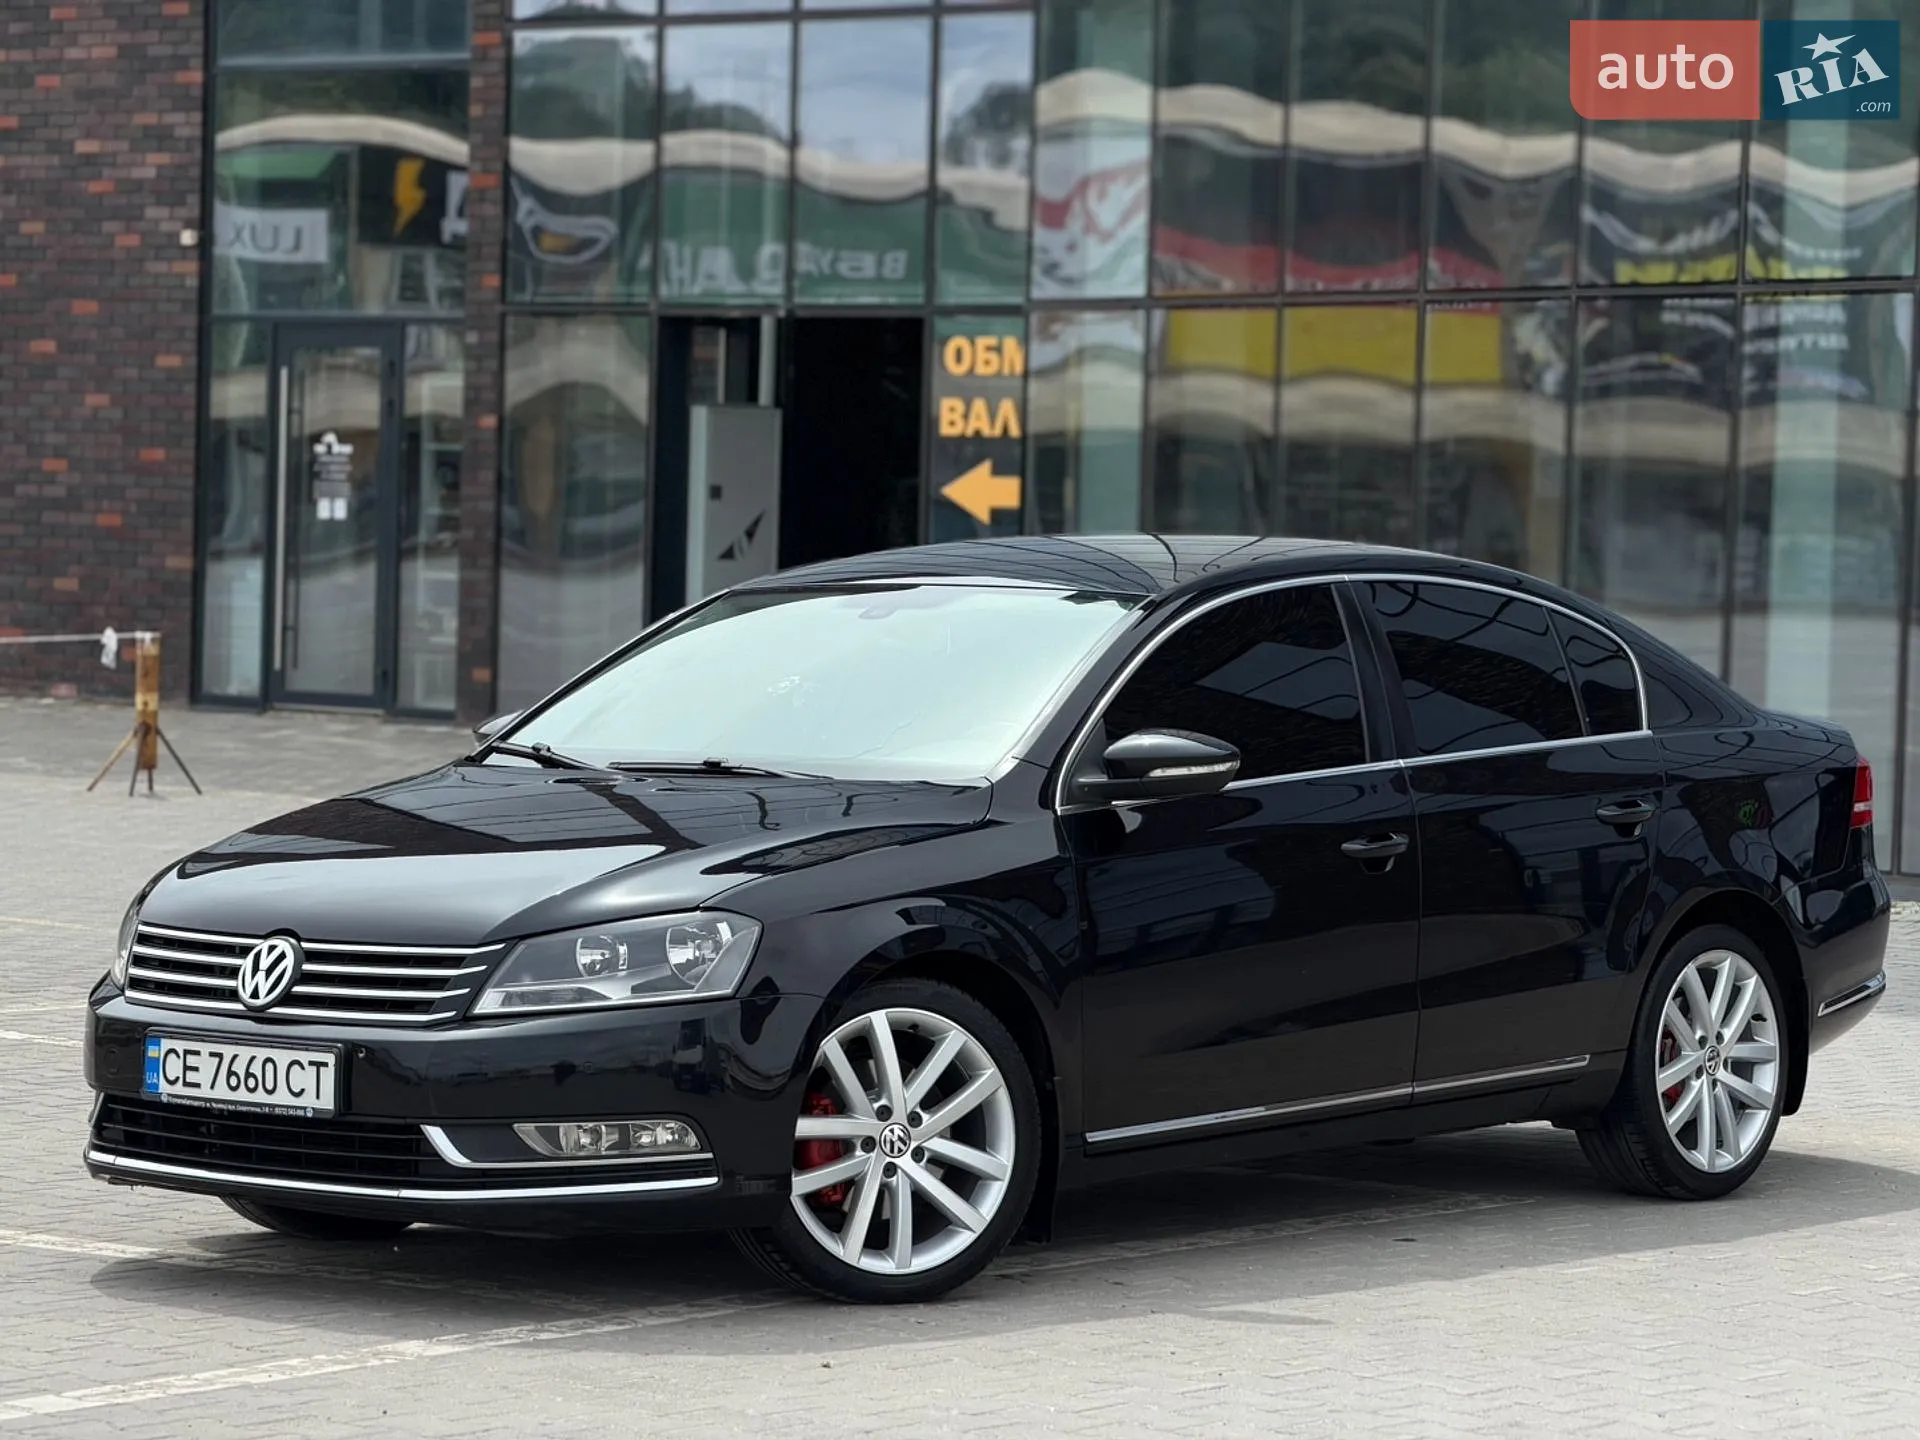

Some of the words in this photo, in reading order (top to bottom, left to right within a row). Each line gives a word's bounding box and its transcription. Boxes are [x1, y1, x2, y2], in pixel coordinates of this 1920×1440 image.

[939, 397, 1023, 439] ВАЛ
[146, 1071, 159, 1084] UA
[162, 1047, 201, 1088] CE
[208, 1051, 278, 1096] 7660
[285, 1059, 329, 1101] CT
